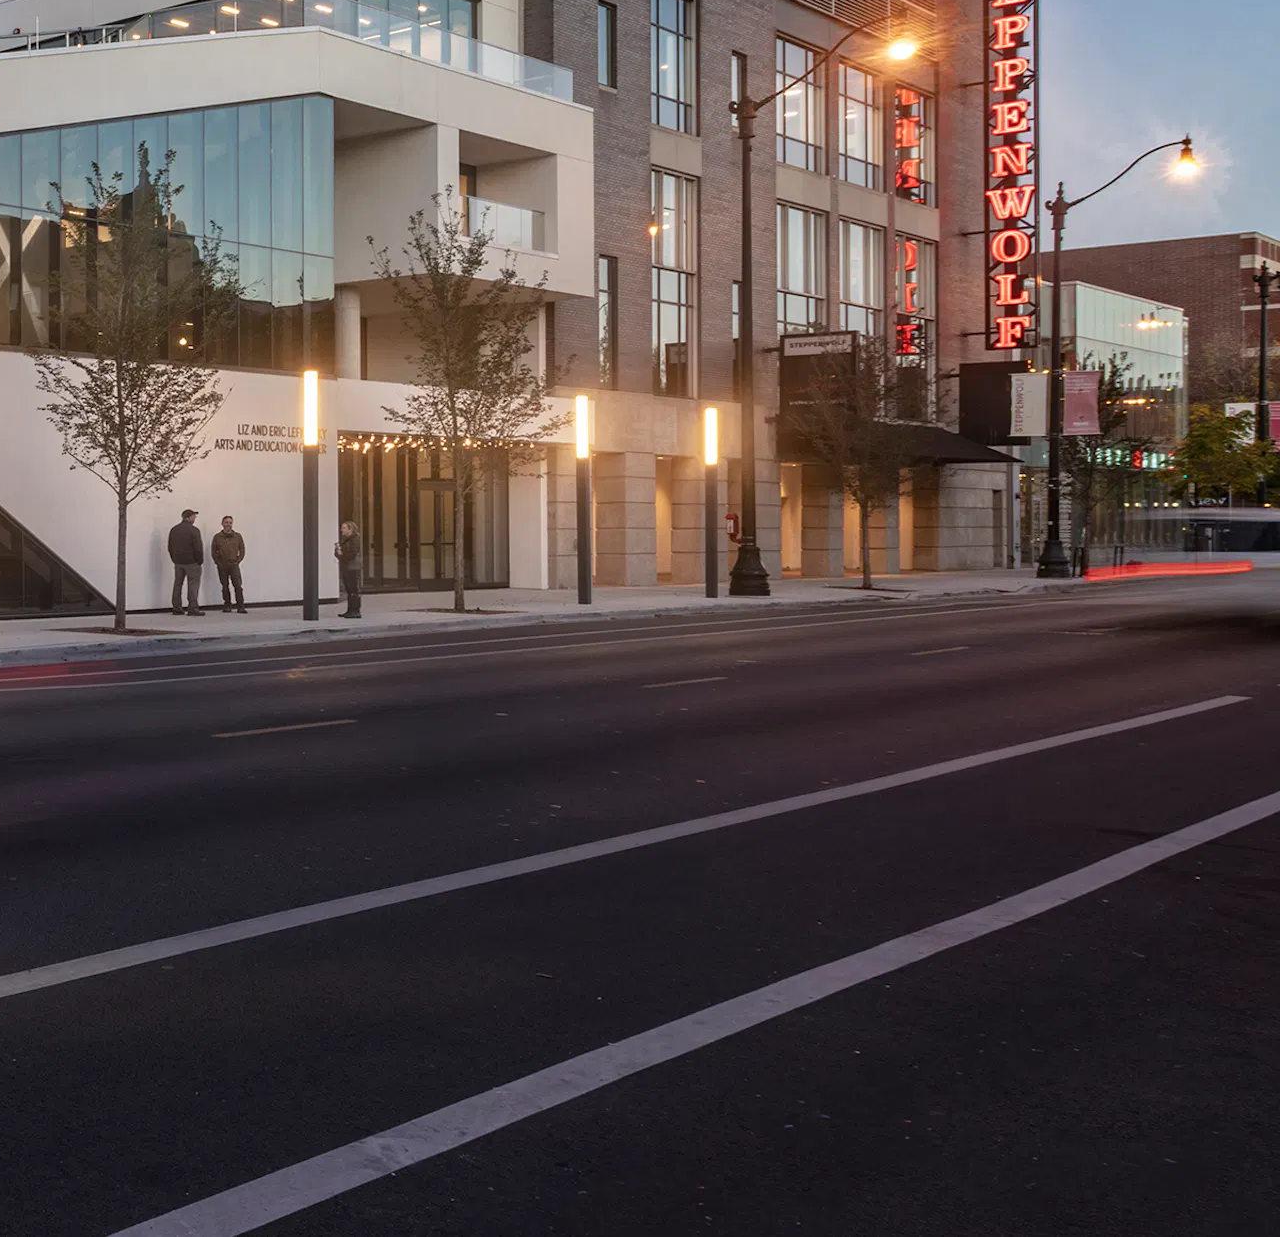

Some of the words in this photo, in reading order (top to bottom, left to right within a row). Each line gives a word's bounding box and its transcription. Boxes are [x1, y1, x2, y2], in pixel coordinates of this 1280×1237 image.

[237, 424, 249, 435] LIZ
[251, 424, 268, 436] AND
[269, 425, 286, 437] ERIC
[214, 438, 235, 450] ARTS
[236, 439, 253, 450] AND
[254, 440, 298, 452] EDUCATION
